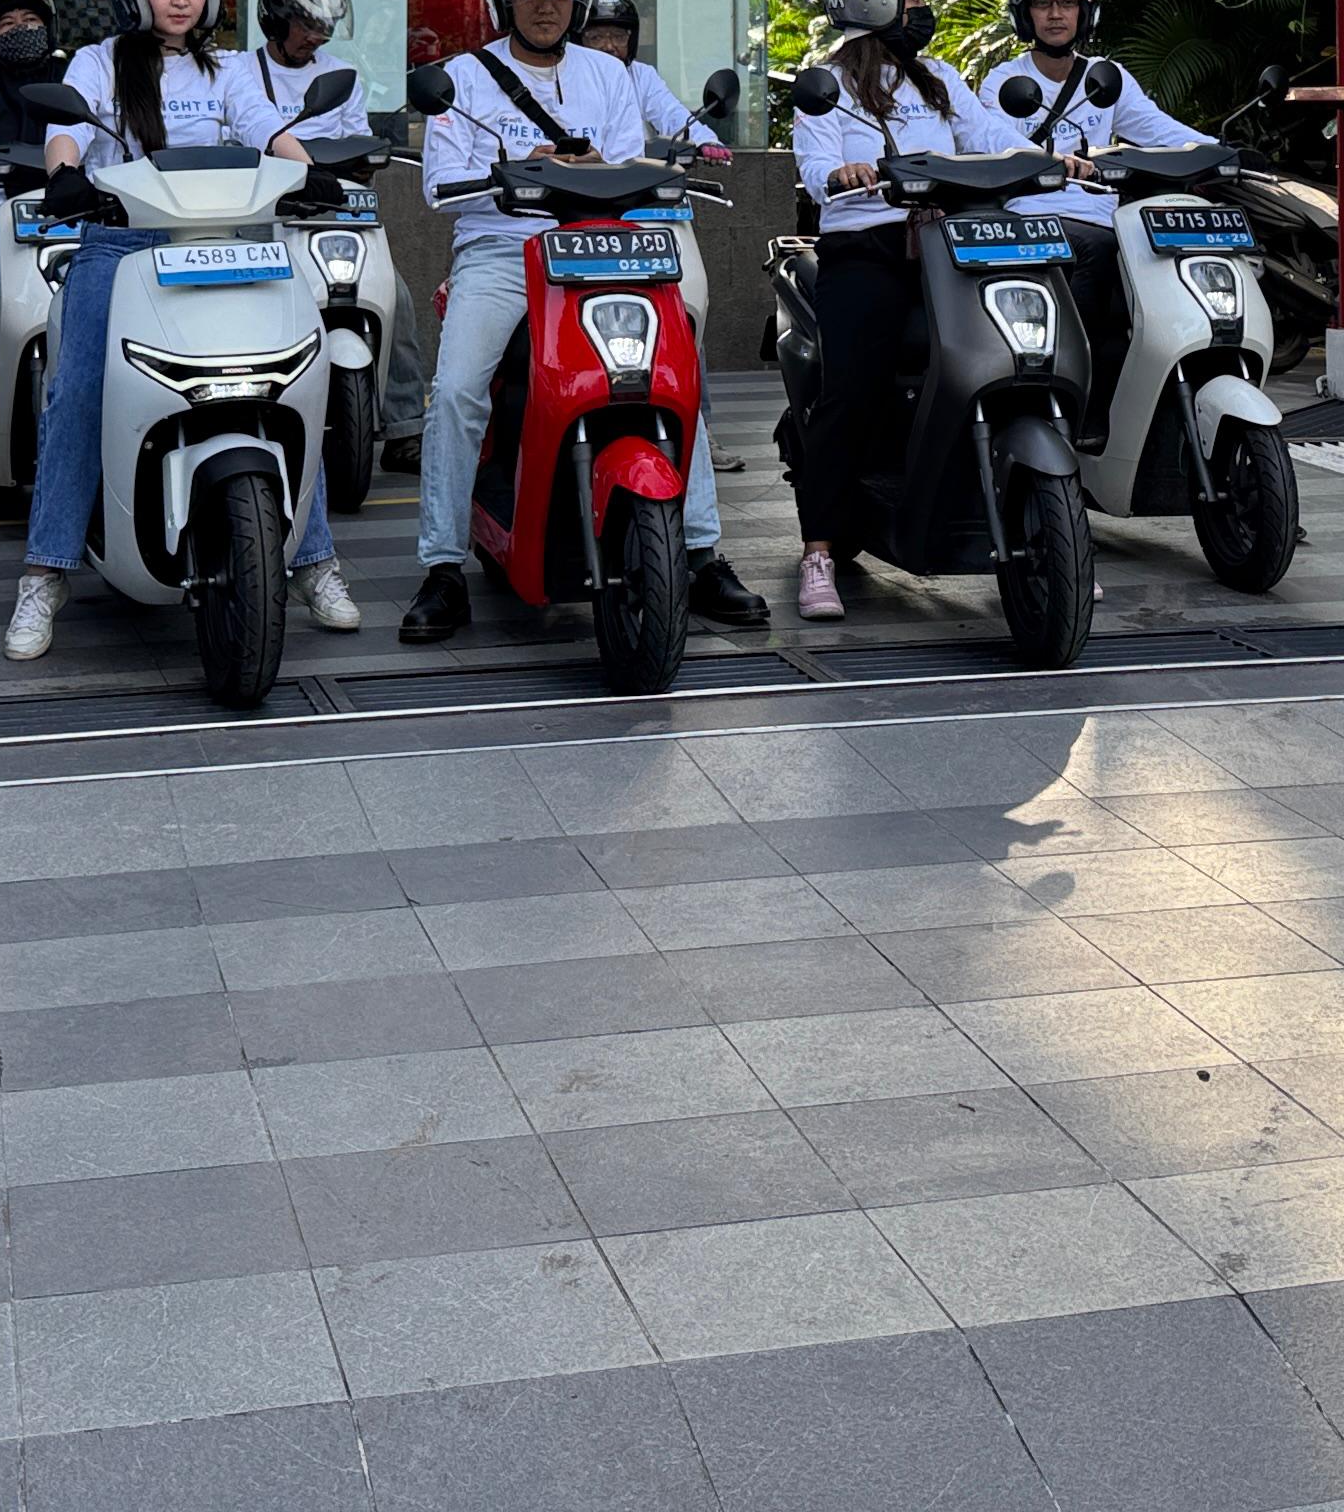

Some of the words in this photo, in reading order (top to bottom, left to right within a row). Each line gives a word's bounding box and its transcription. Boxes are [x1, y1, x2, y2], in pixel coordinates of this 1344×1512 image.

[161, 100, 201, 112] IGHT
[1087, 114, 1103, 127] EV
[499, 123, 529, 138] THE
[582, 126, 598, 139] EV
[1149, 212, 1163, 227] L
[1165, 212, 1206, 228] 6715
[1210, 213, 1243, 228] DAC
[949, 223, 964, 241] L
[971, 222, 1016, 241] 2984
[553, 235, 567, 254] L
[571, 235, 622, 254] 2139
[159, 251, 172, 267] L
[184, 248, 237, 265] 4589
[246, 245, 280, 261] CAV
